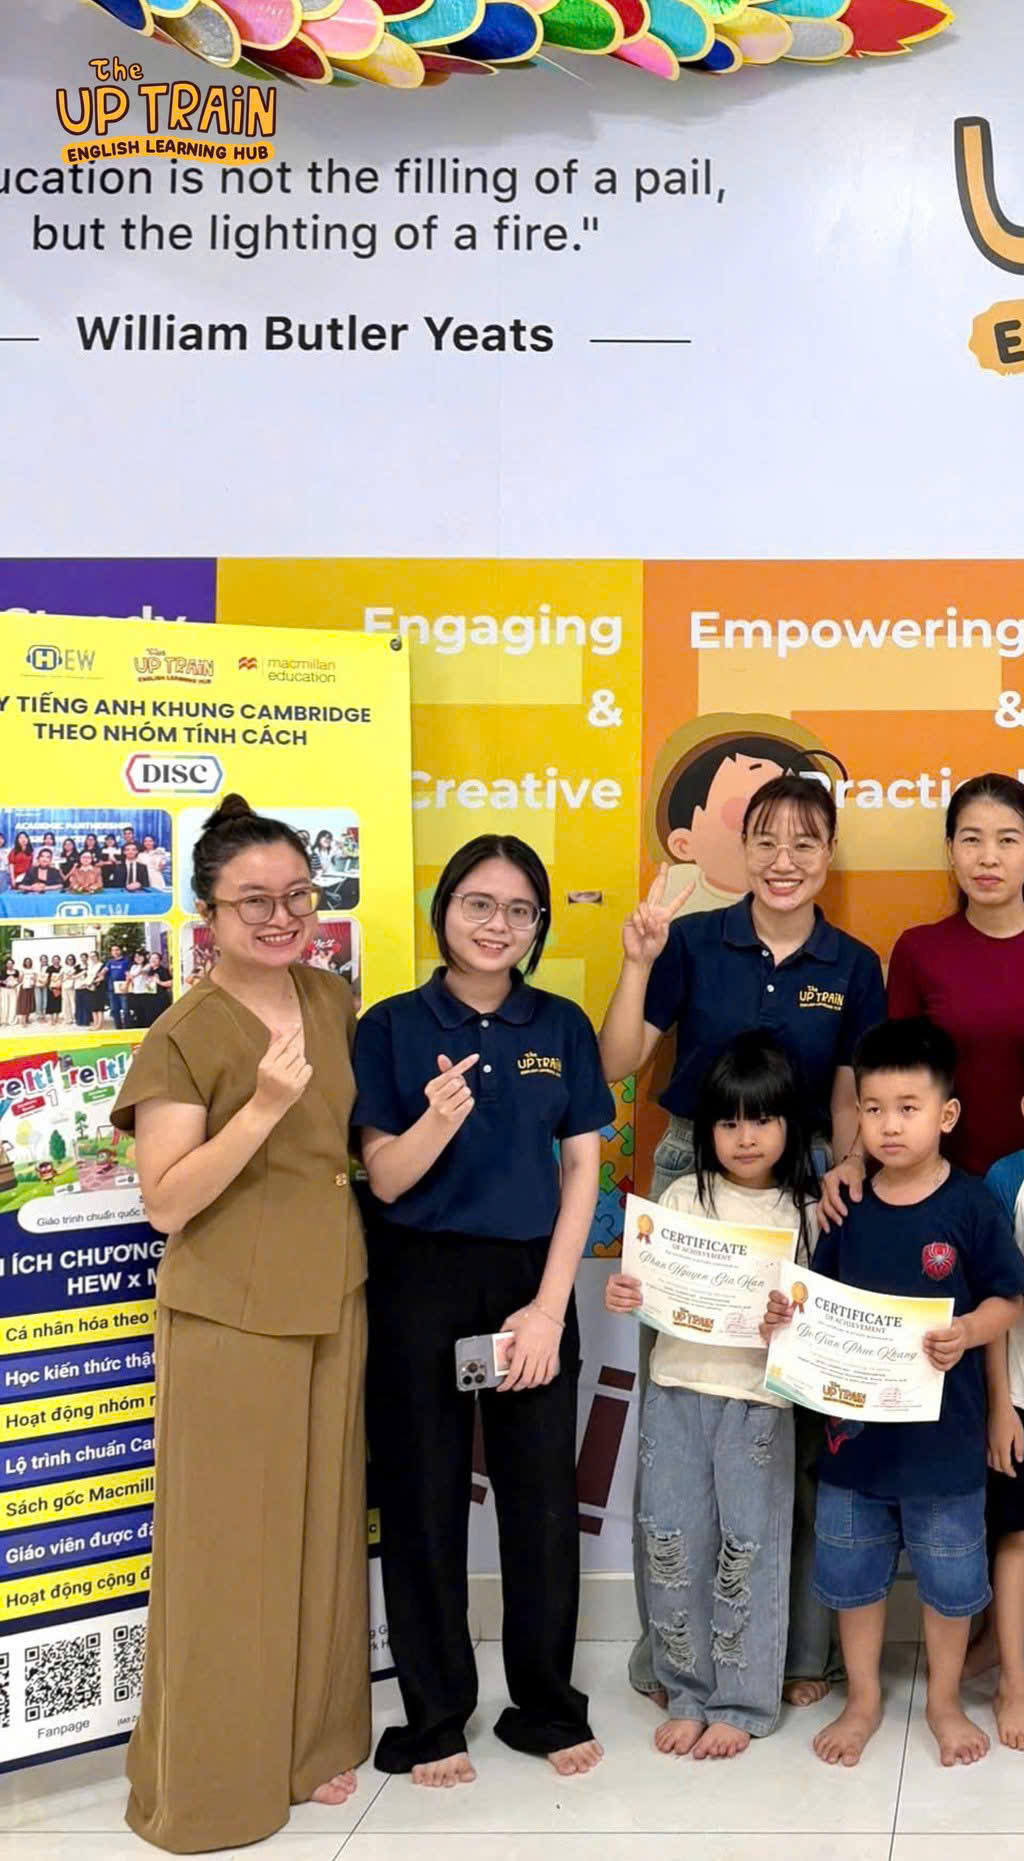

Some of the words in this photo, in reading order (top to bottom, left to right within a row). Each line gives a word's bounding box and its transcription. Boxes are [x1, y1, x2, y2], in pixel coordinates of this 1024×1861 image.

[170, 158, 203, 195] is
[221, 161, 292, 195] not
[307, 158, 379, 195] the
[394, 157, 518, 203] filling
[535, 157, 578, 195] of
[594, 167, 617, 195] a
[636, 158, 726, 204] pail,
[33, 214, 105, 251] but
[121, 214, 193, 251] the
[210, 213, 377, 259] lighting
[395, 214, 438, 251] of
[454, 224, 477, 251] a
[493, 214, 600, 251] fire."
[77, 314, 247, 351] William
[265, 314, 409, 351] Butler
[424, 315, 554, 353] Yeats
[364, 603, 623, 656] Engaging
[267, 658, 336, 671] macmillan
[267, 670, 336, 683] education
[17, 692, 88, 714] TIẾNG
[94, 699, 146, 716] ANH
[152, 701, 234, 719] KHUNG
[240, 704, 371, 723] CAMBRIDGE
[588, 689, 623, 728] &
[34, 722, 97, 742] THEO
[103, 722, 177, 743] NHÓM
[184, 723, 236, 744] TÍNH
[242, 725, 308, 746] CÁCH
[142, 763, 208, 784] DISC
[799, 991, 815, 1002] UP
[517, 1057, 535, 1069] UP
[12, 1252, 53, 1276] ÍCH
[59, 1239, 165, 1270] CHƯƠNG
[660, 1227, 748, 1257] CERTIFICATE
[67, 1272, 122, 1296] HEW
[5, 1325, 28, 1342] Cá
[33, 1321, 74, 1339] nhân
[78, 1315, 109, 1333] hóa
[113, 1311, 150, 1328] theo
[814, 1296, 904, 1328] CERTIFICATE
[5, 1370, 41, 1388] Học
[44, 1362, 80, 1381] kiến
[84, 1357, 122, 1376] thức
[5, 1411, 47, 1429] Hoạt
[51, 1405, 94, 1423] động
[99, 1396, 145, 1415] nhóm
[5, 1457, 27, 1475] Lộ
[31, 1451, 71, 1469] trình
[75, 1440, 127, 1462] chuẩn
[6, 1497, 48, 1517] Sách
[53, 1491, 85, 1511] gốc
[5, 1545, 46, 1564] Giáo
[50, 1537, 85, 1555] viên
[89, 1530, 134, 1547] được
[6, 1589, 46, 1608] Hoạt
[50, 1581, 93, 1599] động
[96, 1571, 136, 1590] cộng
[37, 1719, 91, 1739] Fanpage
